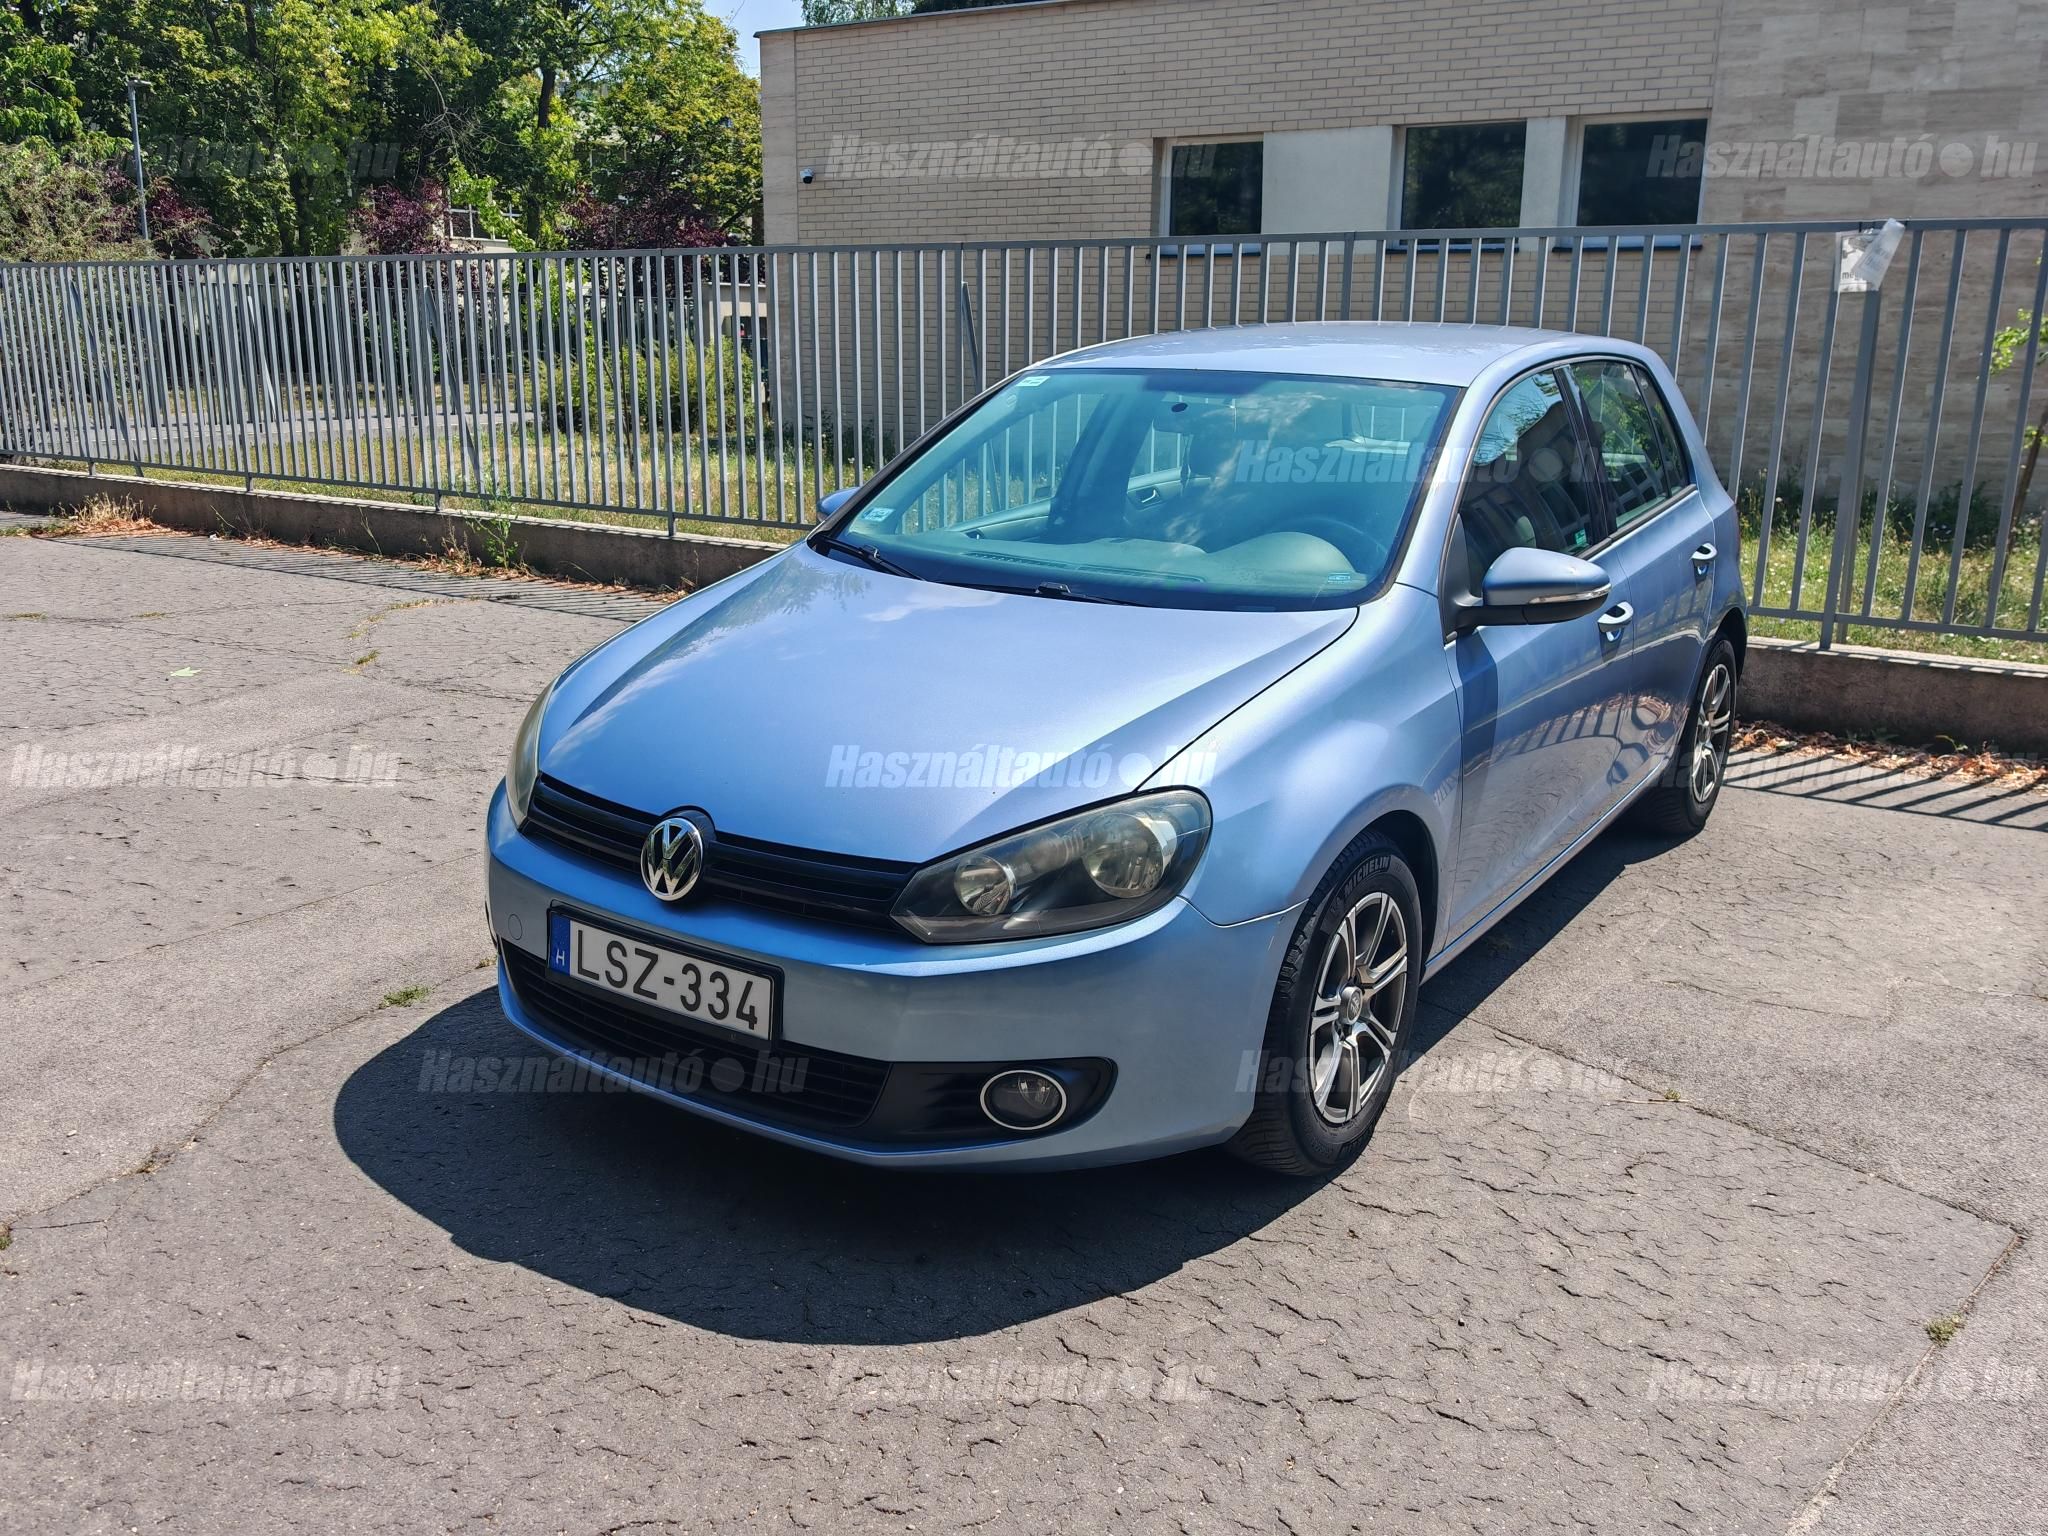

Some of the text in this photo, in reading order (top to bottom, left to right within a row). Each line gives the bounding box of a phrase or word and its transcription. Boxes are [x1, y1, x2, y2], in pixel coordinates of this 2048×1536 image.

[1344, 855, 1390, 897] MICHELIN
[555, 948, 565, 967] H
[577, 929, 758, 1031] LSZ-334
